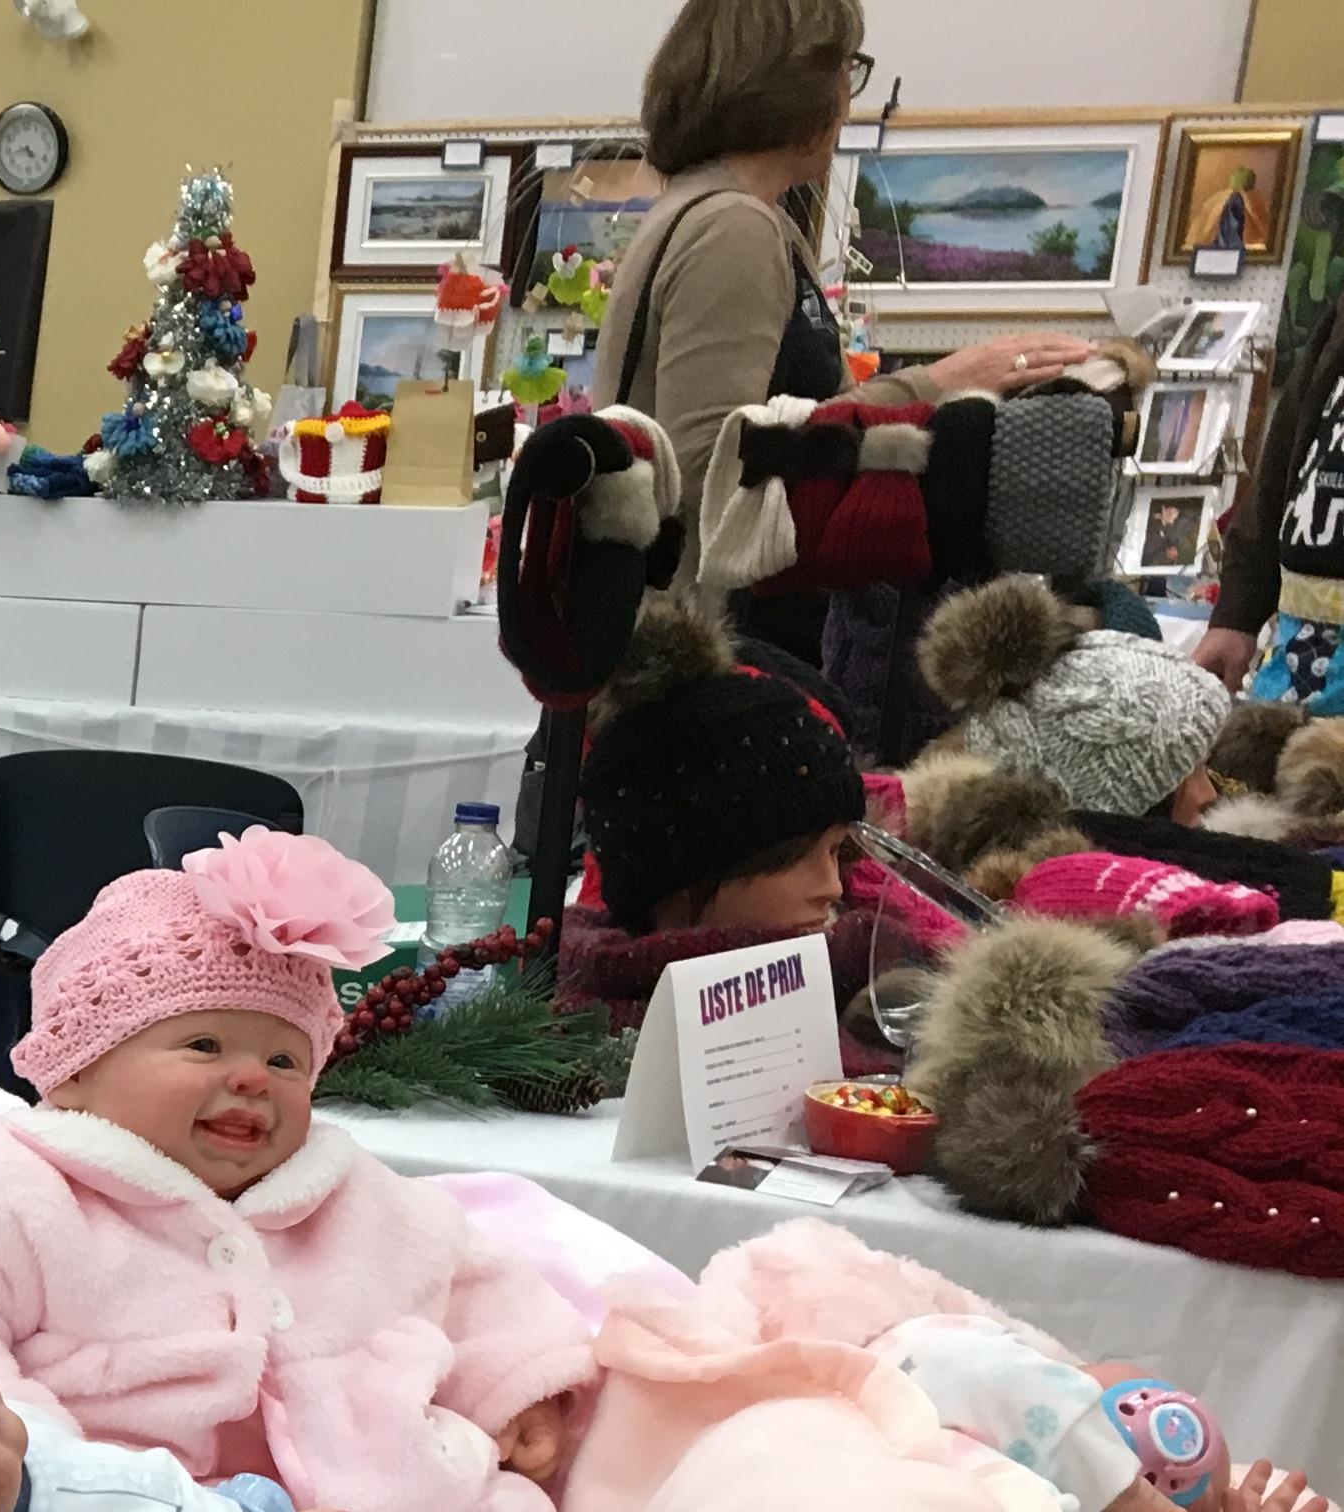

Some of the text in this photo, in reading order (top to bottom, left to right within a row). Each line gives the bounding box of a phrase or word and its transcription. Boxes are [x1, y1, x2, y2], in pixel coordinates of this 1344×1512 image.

[699, 953, 806, 1025] LISTE DE PRIX
